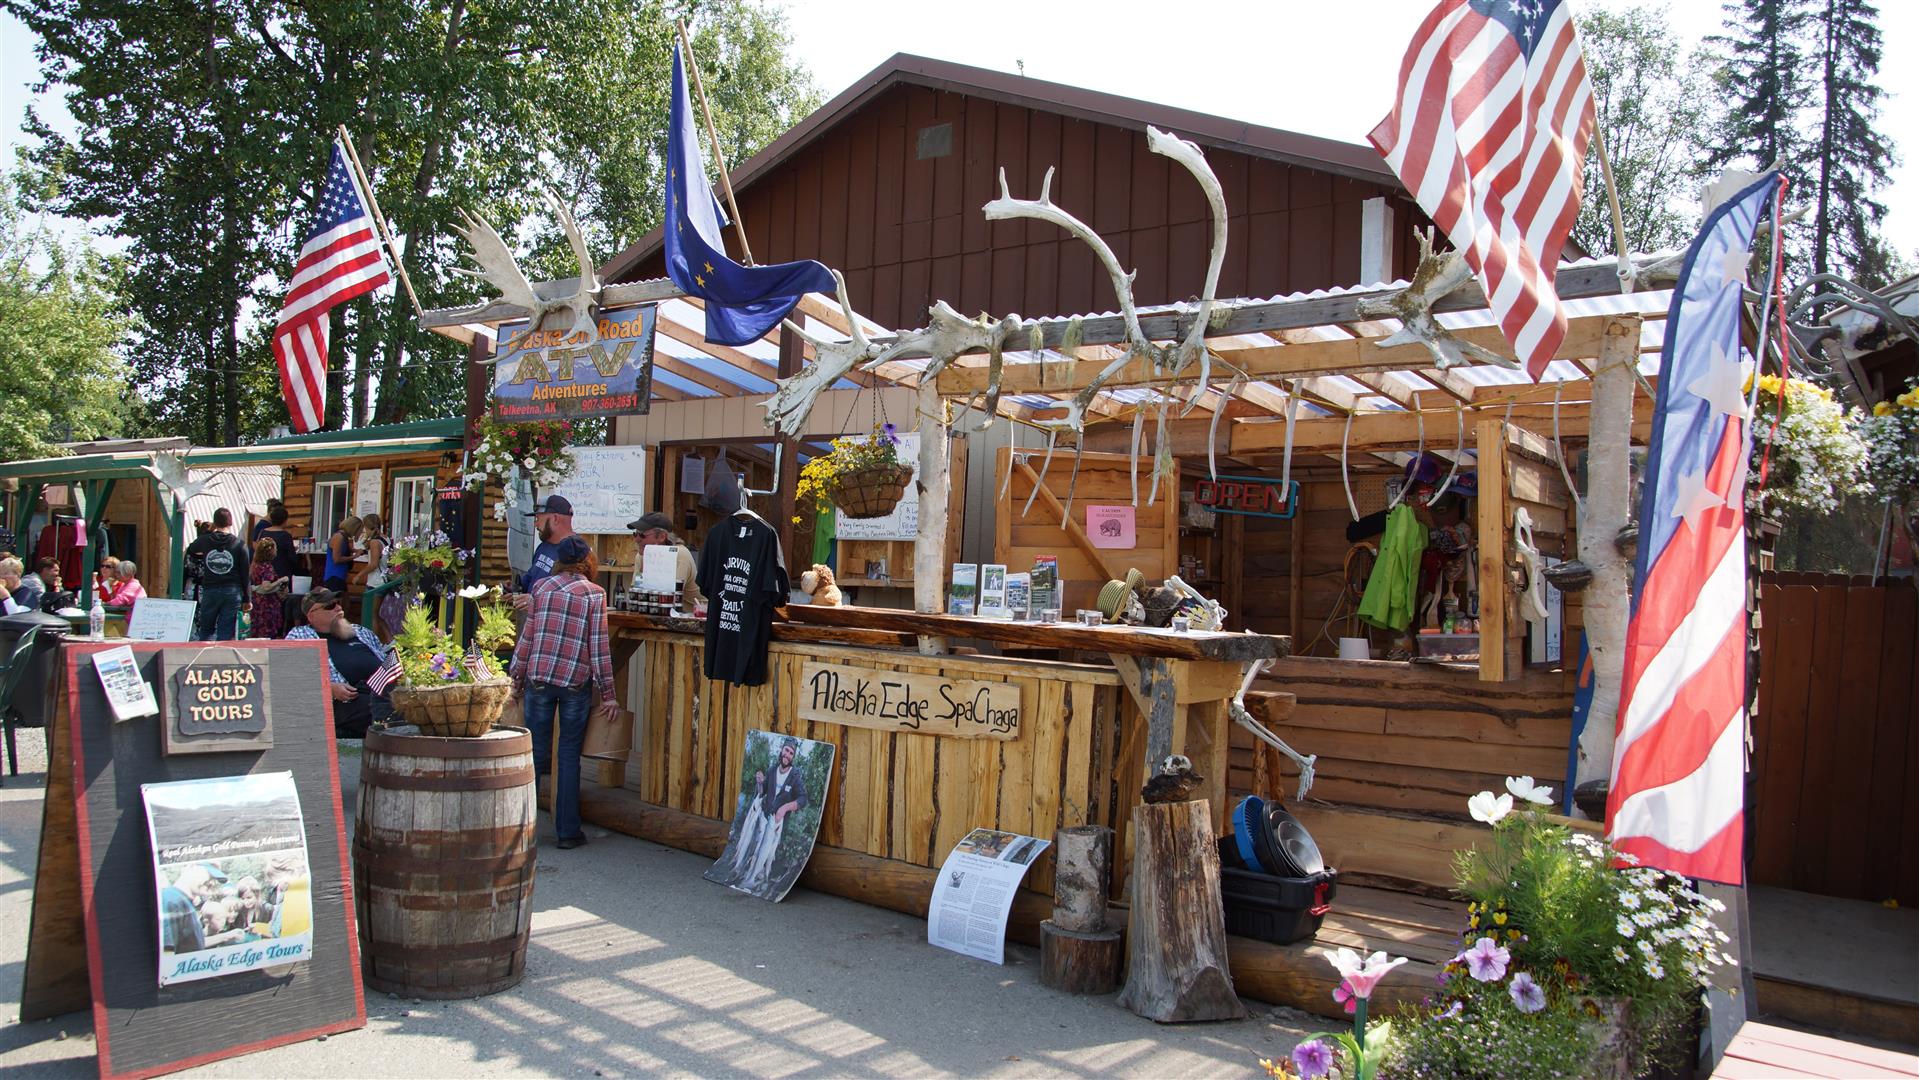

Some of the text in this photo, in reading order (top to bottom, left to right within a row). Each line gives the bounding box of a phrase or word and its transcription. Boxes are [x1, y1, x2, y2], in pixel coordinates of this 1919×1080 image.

[600, 312, 643, 341] Road
[509, 341, 636, 385] ATV
[532, 382, 608, 401] Adventures
[499, 404, 542, 417] Talkeetna,
[544, 401, 556, 414] AK
[1195, 480, 1286, 513] OPEN
[185, 669, 256, 685] ALASKA
[197, 685, 247, 702] GOLD
[810, 670, 876, 716] Alaska
[879, 681, 929, 729] Edge
[190, 704, 253, 721] TOURS
[213, 840, 230, 853] Gold
[171, 942, 303, 977] Alaska Edge Tours
